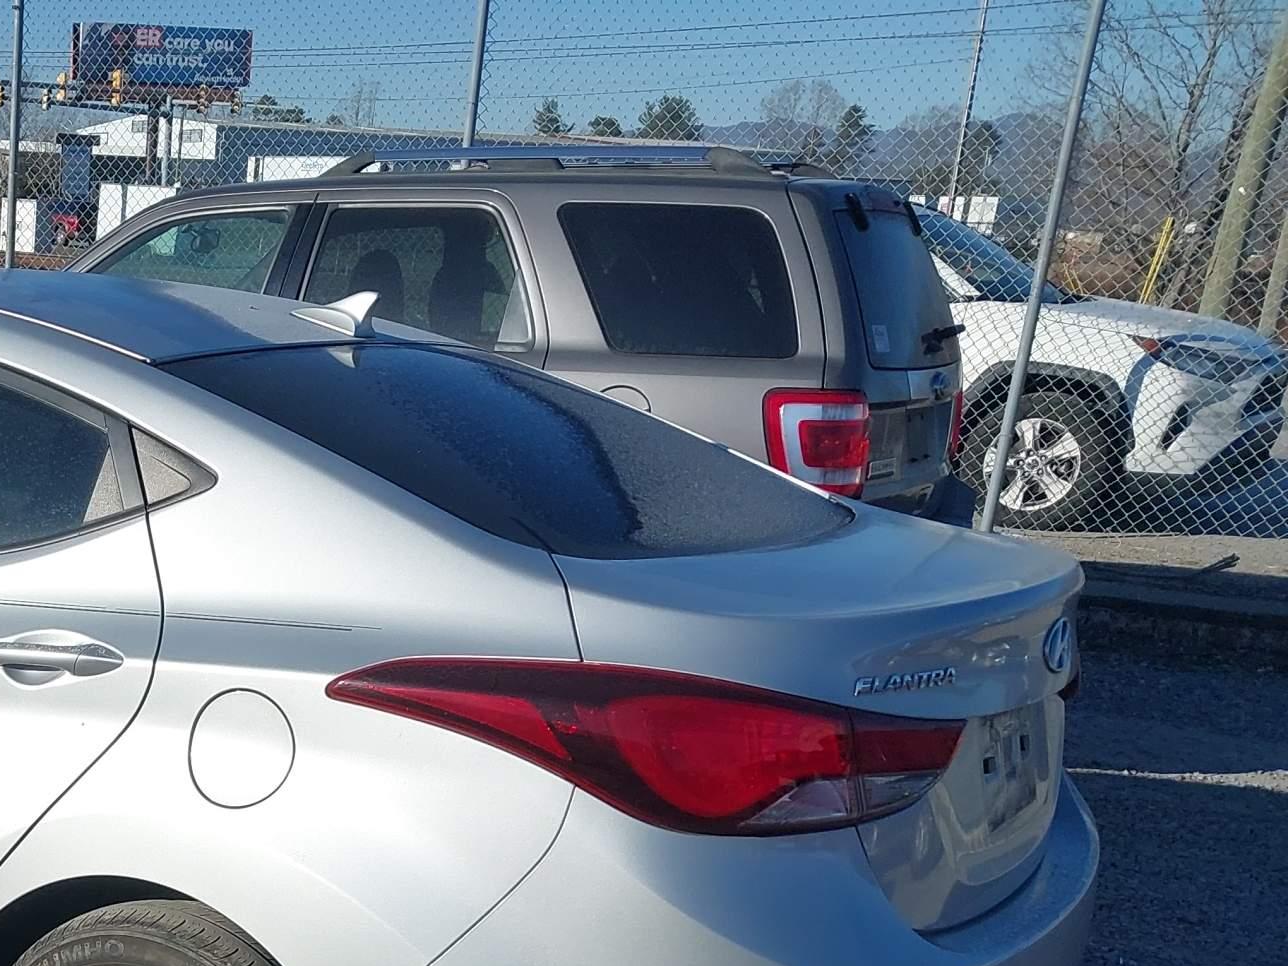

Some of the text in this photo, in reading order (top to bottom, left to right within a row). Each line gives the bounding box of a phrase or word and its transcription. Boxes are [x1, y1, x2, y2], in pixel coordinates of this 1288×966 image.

[136, 28, 234, 53] ER care you
[134, 52, 162, 64] can
[854, 667, 956, 697] ELANTRA
